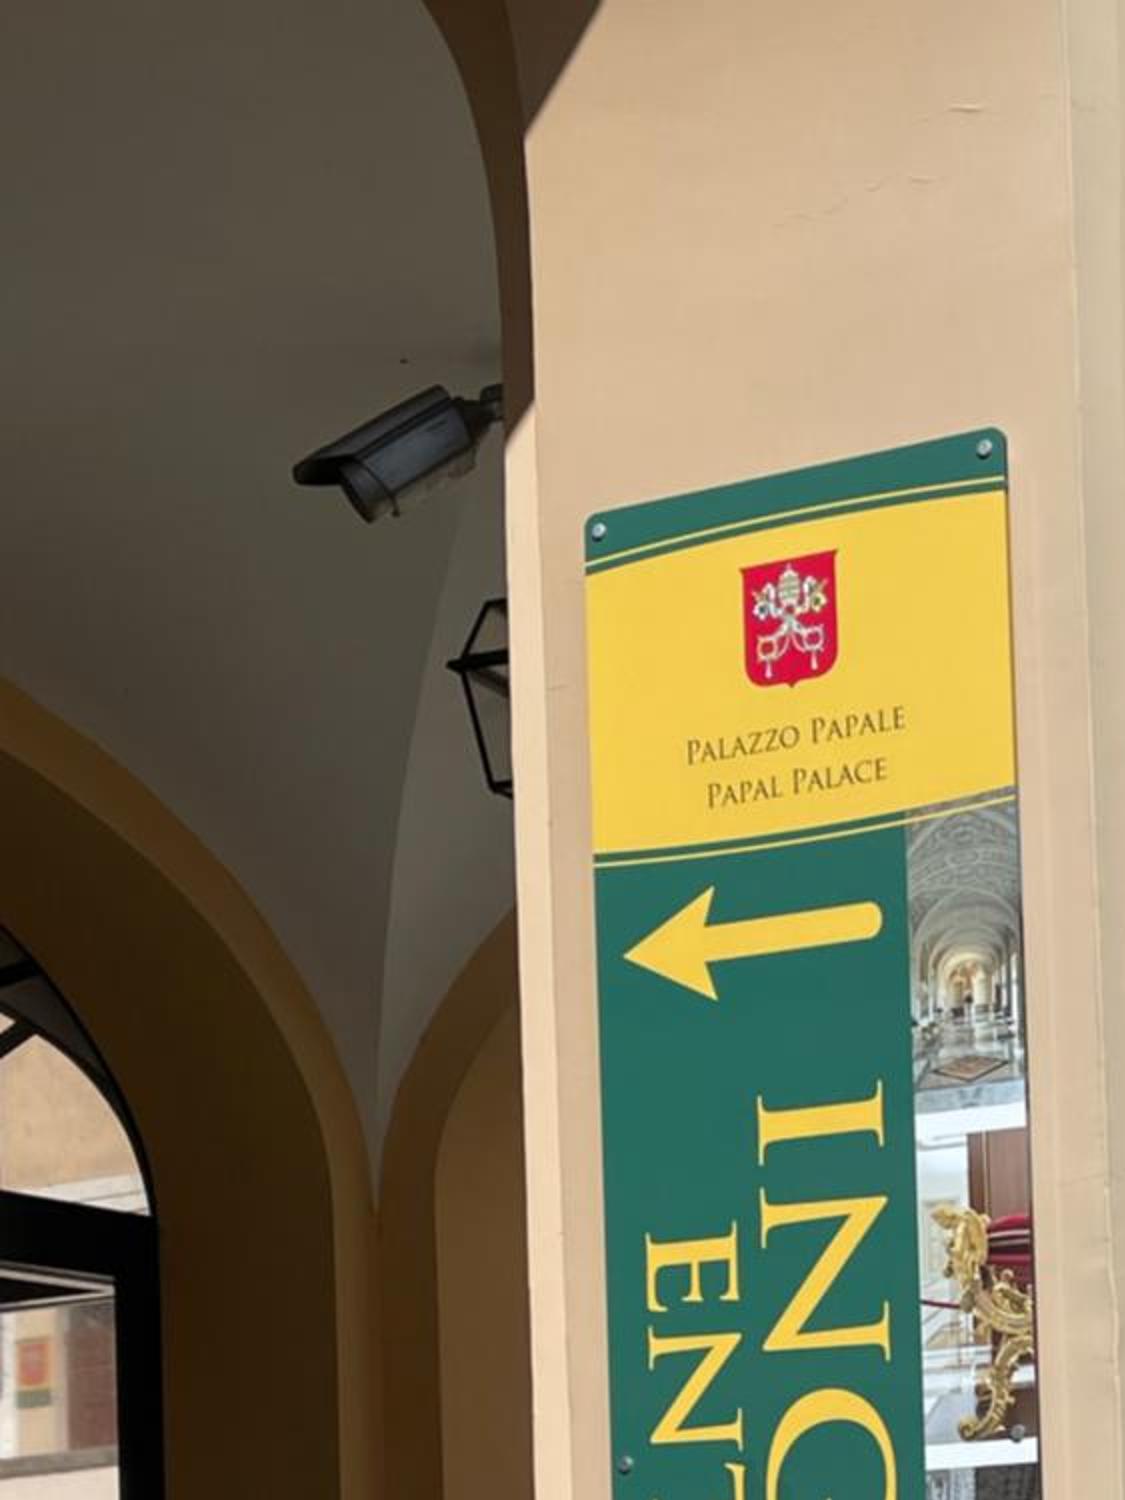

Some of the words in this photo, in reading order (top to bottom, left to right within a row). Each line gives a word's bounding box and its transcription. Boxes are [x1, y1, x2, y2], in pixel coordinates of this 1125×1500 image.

[687, 725, 800, 766] PALAZZO
[810, 705, 906, 745] PAPALE
[707, 774, 783, 811] PAPAL
[792, 757, 888, 795] PALACE
